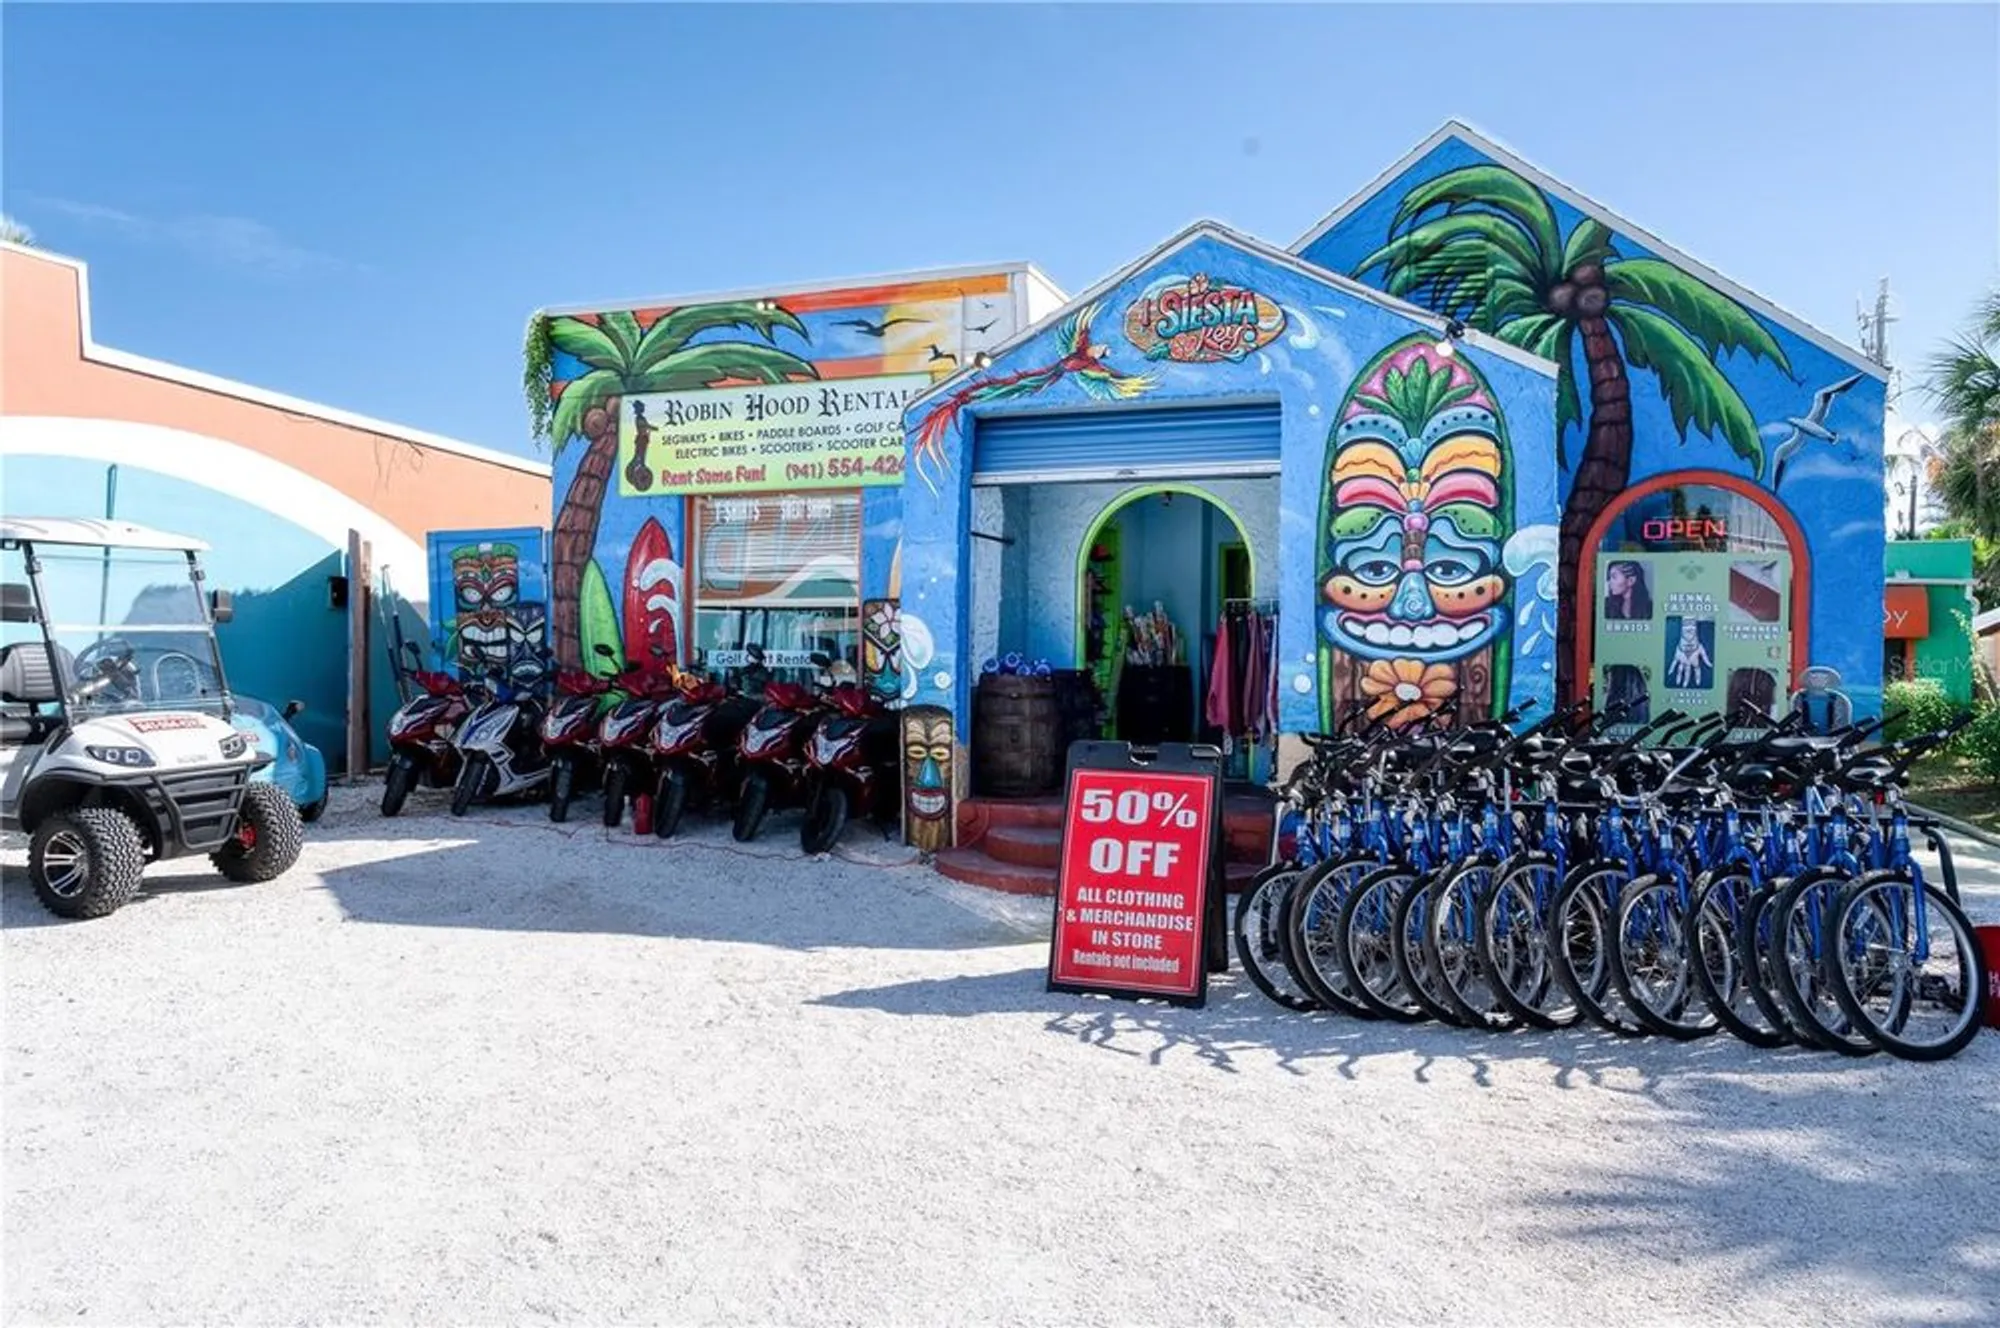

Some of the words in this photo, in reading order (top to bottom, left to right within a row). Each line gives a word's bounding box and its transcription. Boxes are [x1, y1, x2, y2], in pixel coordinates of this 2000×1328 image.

[1157, 289, 1258, 338] SIESTA
[1198, 325, 1244, 351] Key
[819, 387, 923, 417] RENTAL
[662, 433, 707, 446] SEGWAYS
[719, 430, 745, 442] BIKES
[756, 427, 795, 439] PADDLE
[799, 424, 841, 437] BOARDS
[854, 421, 884, 433] GOLF
[676, 447, 719, 459] ELECTRIC
[722, 444, 747, 457] BIKES
[760, 441, 814, 455] SCOOTERS
[827, 438, 877, 451] SCOOTER
[661, 469, 694, 487] Rent
[695, 466, 733, 485] Some
[735, 464, 766, 483] Fun!
[786, 462, 824, 481] (941)
[1643, 519, 1726, 539] OPEN
[1663, 603, 1720, 612] TATTOOS
[716, 652, 741, 665] Golf
[777, 652, 813, 665] Renta
[1081, 788, 1197, 828] 50%
[1089, 837, 1181, 878] OFF
[1077, 886, 1103, 903] ALL
[1106, 888, 1184, 909] CLOTHING
[1066, 908, 1077, 923] &
[1080, 907, 1193, 931] MERCHANDISE
[1091, 929, 1108, 945] IN
[1112, 931, 1163, 950] STORE
[1072, 948, 1112, 967] Rentals
[1112, 953, 1132, 969] not
[1132, 954, 1180, 973] included
